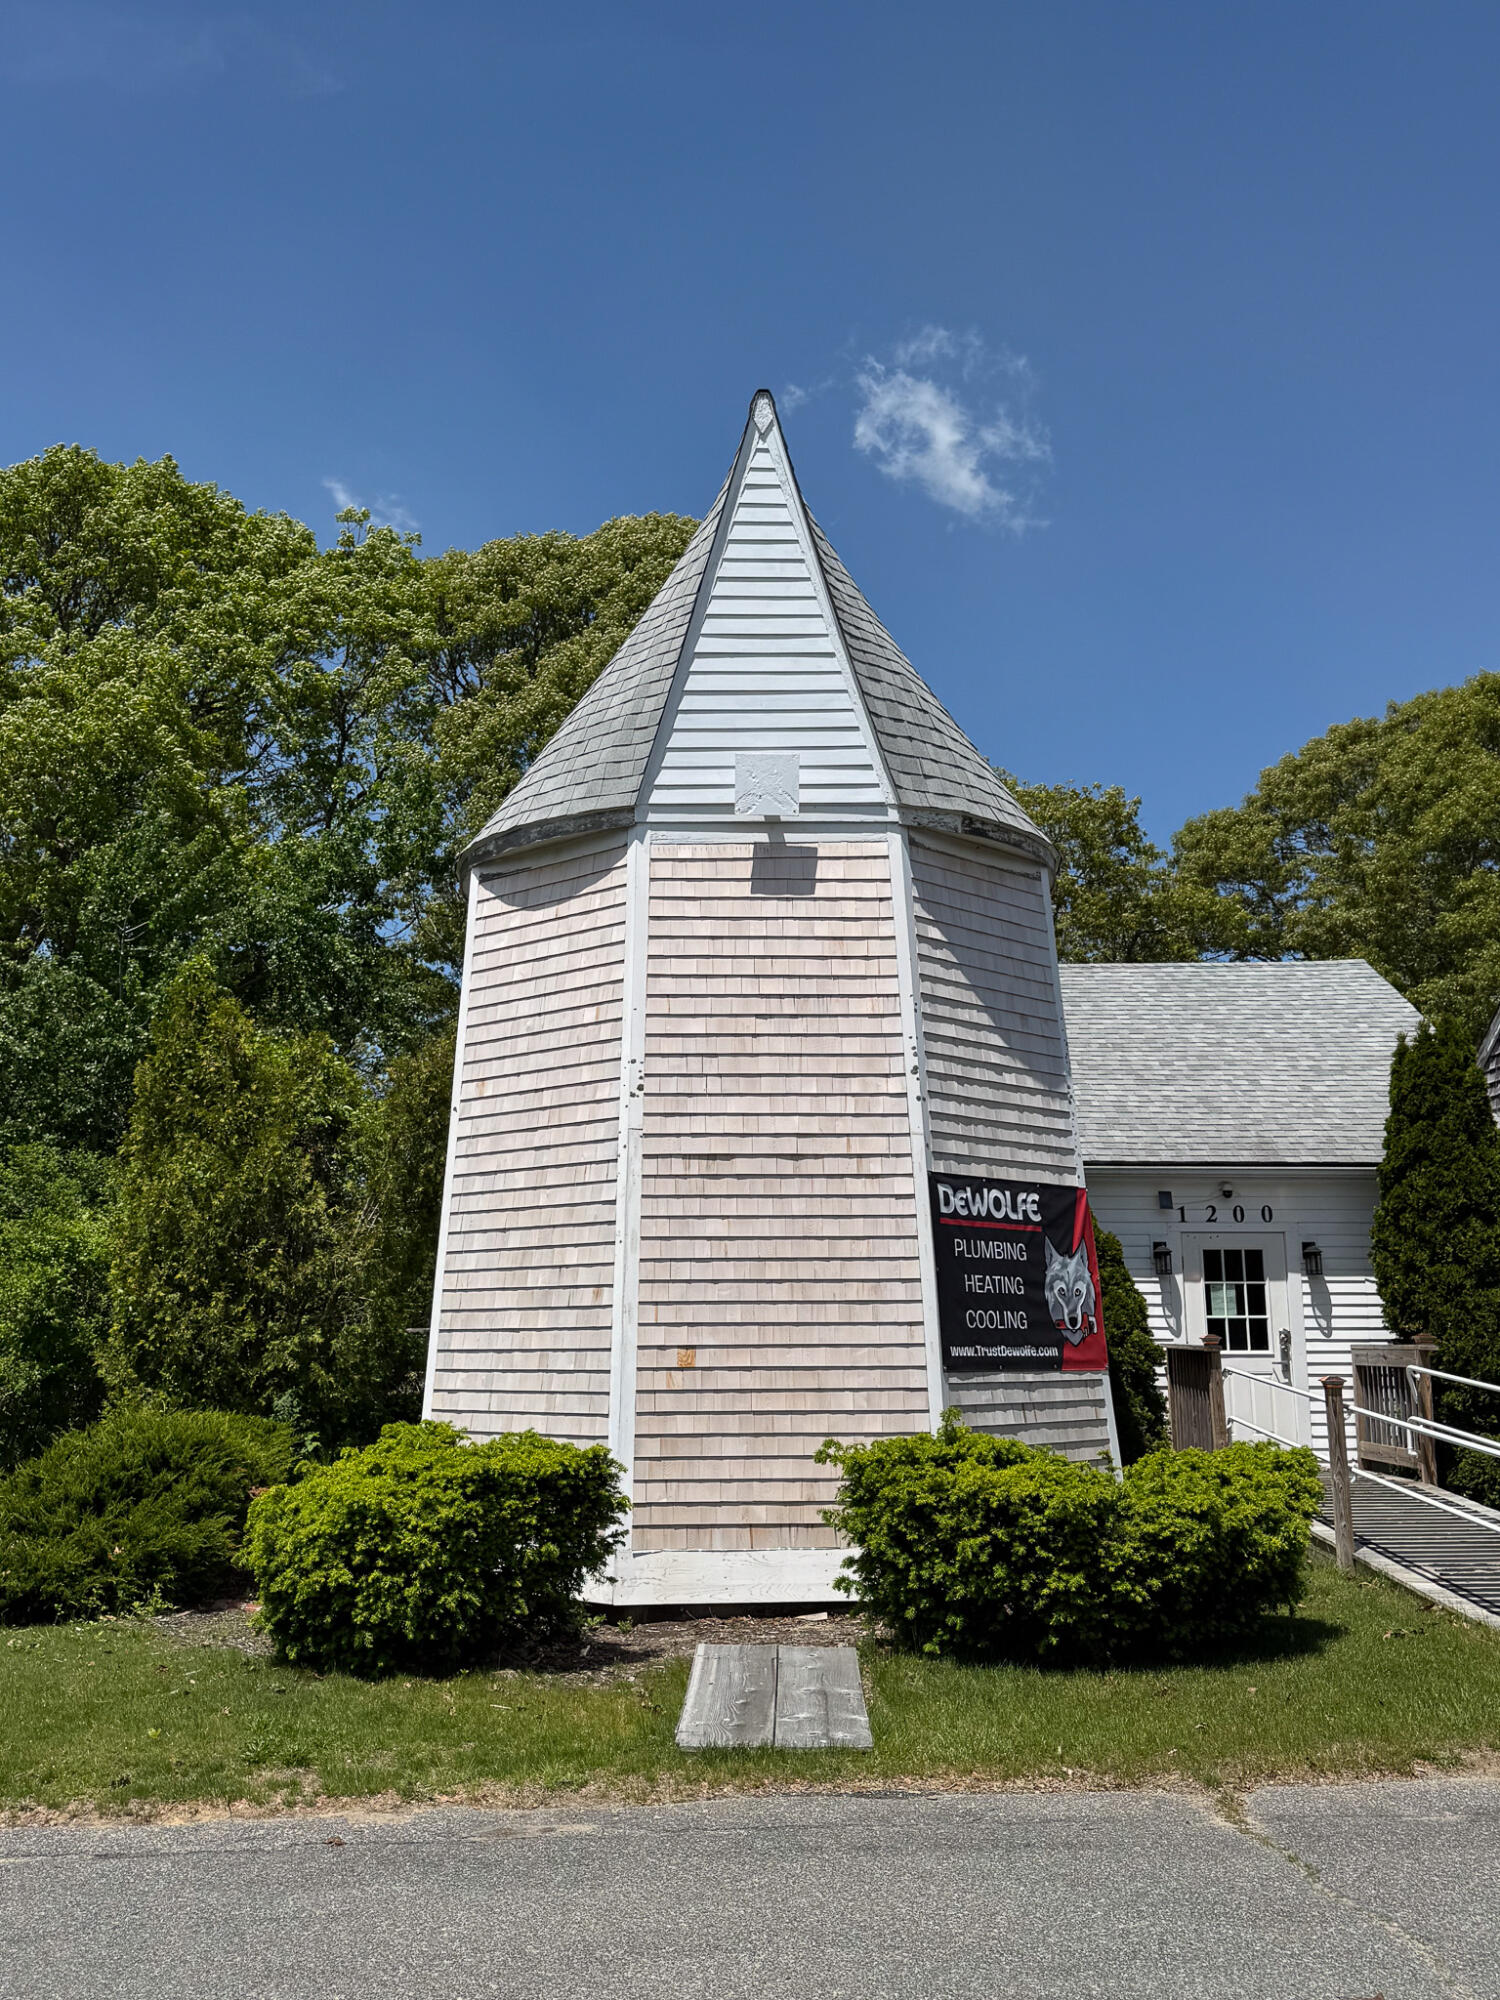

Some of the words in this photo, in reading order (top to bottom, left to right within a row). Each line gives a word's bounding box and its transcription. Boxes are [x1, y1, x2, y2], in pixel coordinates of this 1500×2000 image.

[1176, 1205, 1273, 1223] 1200
[954, 1238, 1027, 1261] PLUMBING
[964, 1274, 1025, 1295] HEATING
[966, 1309, 1028, 1329] COOLING
